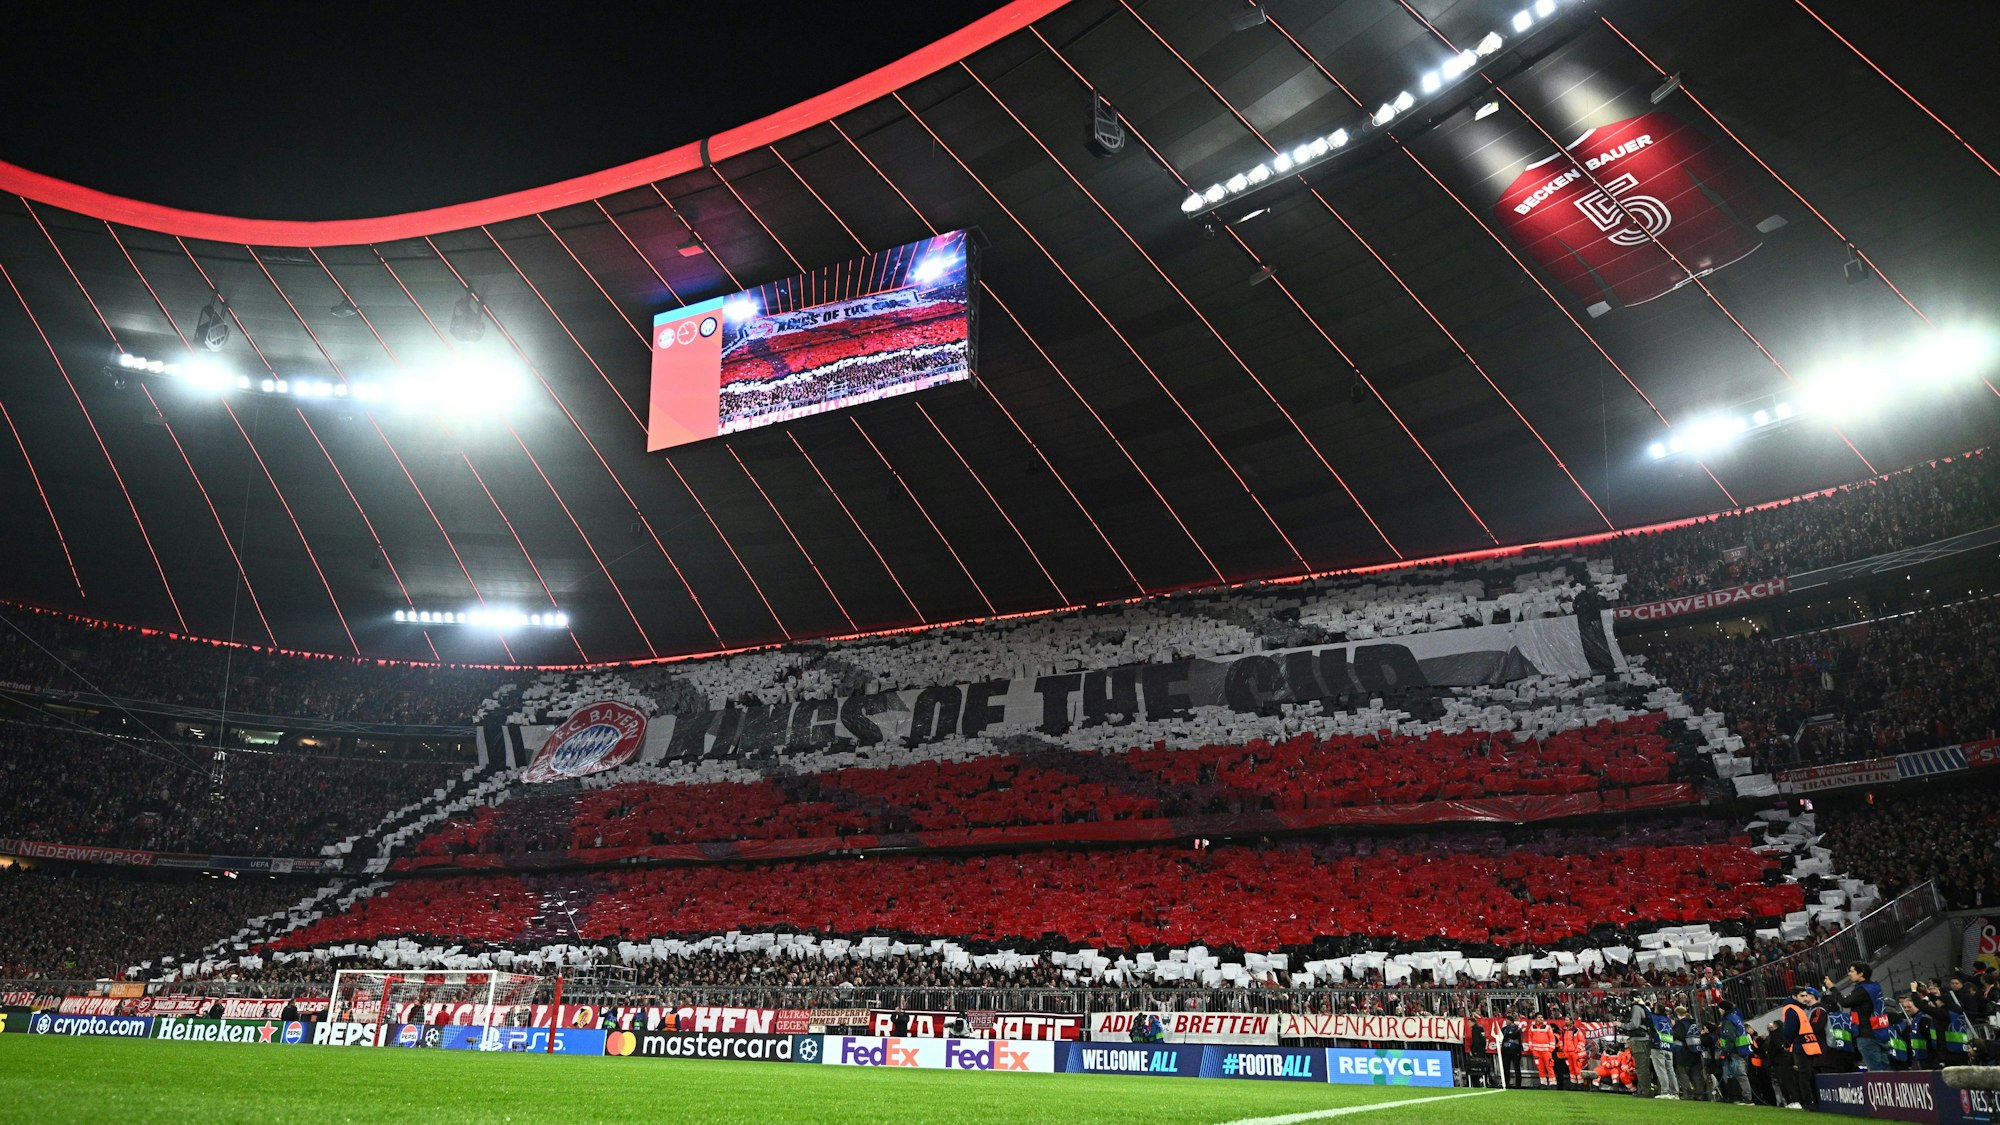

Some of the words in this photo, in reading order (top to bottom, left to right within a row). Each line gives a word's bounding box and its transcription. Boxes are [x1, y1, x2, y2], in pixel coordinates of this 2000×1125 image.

[1572, 172, 1672, 247] 5
[907, 678, 1009, 749] OF
[1034, 661, 1194, 737] THE
[1224, 643, 1430, 717] CUP
[1801, 774, 1891, 791] TRAUNSTEIN
[250, 860, 270, 870] UEFA
[54, 1016, 144, 1037] crypto.com
[776, 1020, 808, 1031] GEGEN
[778, 1009, 810, 1020] ULTRAS
[810, 1017, 836, 1025] IMMER
[838, 1017, 850, 1025] BEI
[852, 1016, 868, 1025] UNS
[1174, 1015, 1270, 1035] BRETTEN
[157, 1018, 255, 1043] Heineken
[287, 1030, 301, 1038] PEPSI
[313, 1022, 388, 1048] PEPSI
[1285, 1014, 1462, 1040] ANZENKIRCHEN
[1585, 1026, 1614, 1039] BAYERN
[508, 1031, 565, 1053] PS5
[642, 1032, 792, 1060] mastercard
[841, 1036, 919, 1067] FedEx
[945, 1039, 1030, 1071] FedEx
[1082, 1048, 1148, 1072] WELCOME
[1149, 1050, 1178, 1073] ALL
[1222, 1053, 1312, 1078] #FOOTBALL
[1339, 1055, 1441, 1078] RECYCLE
[1868, 1081, 1895, 1111] QATAR
[1895, 1083, 1934, 1111] AIRWAYS
